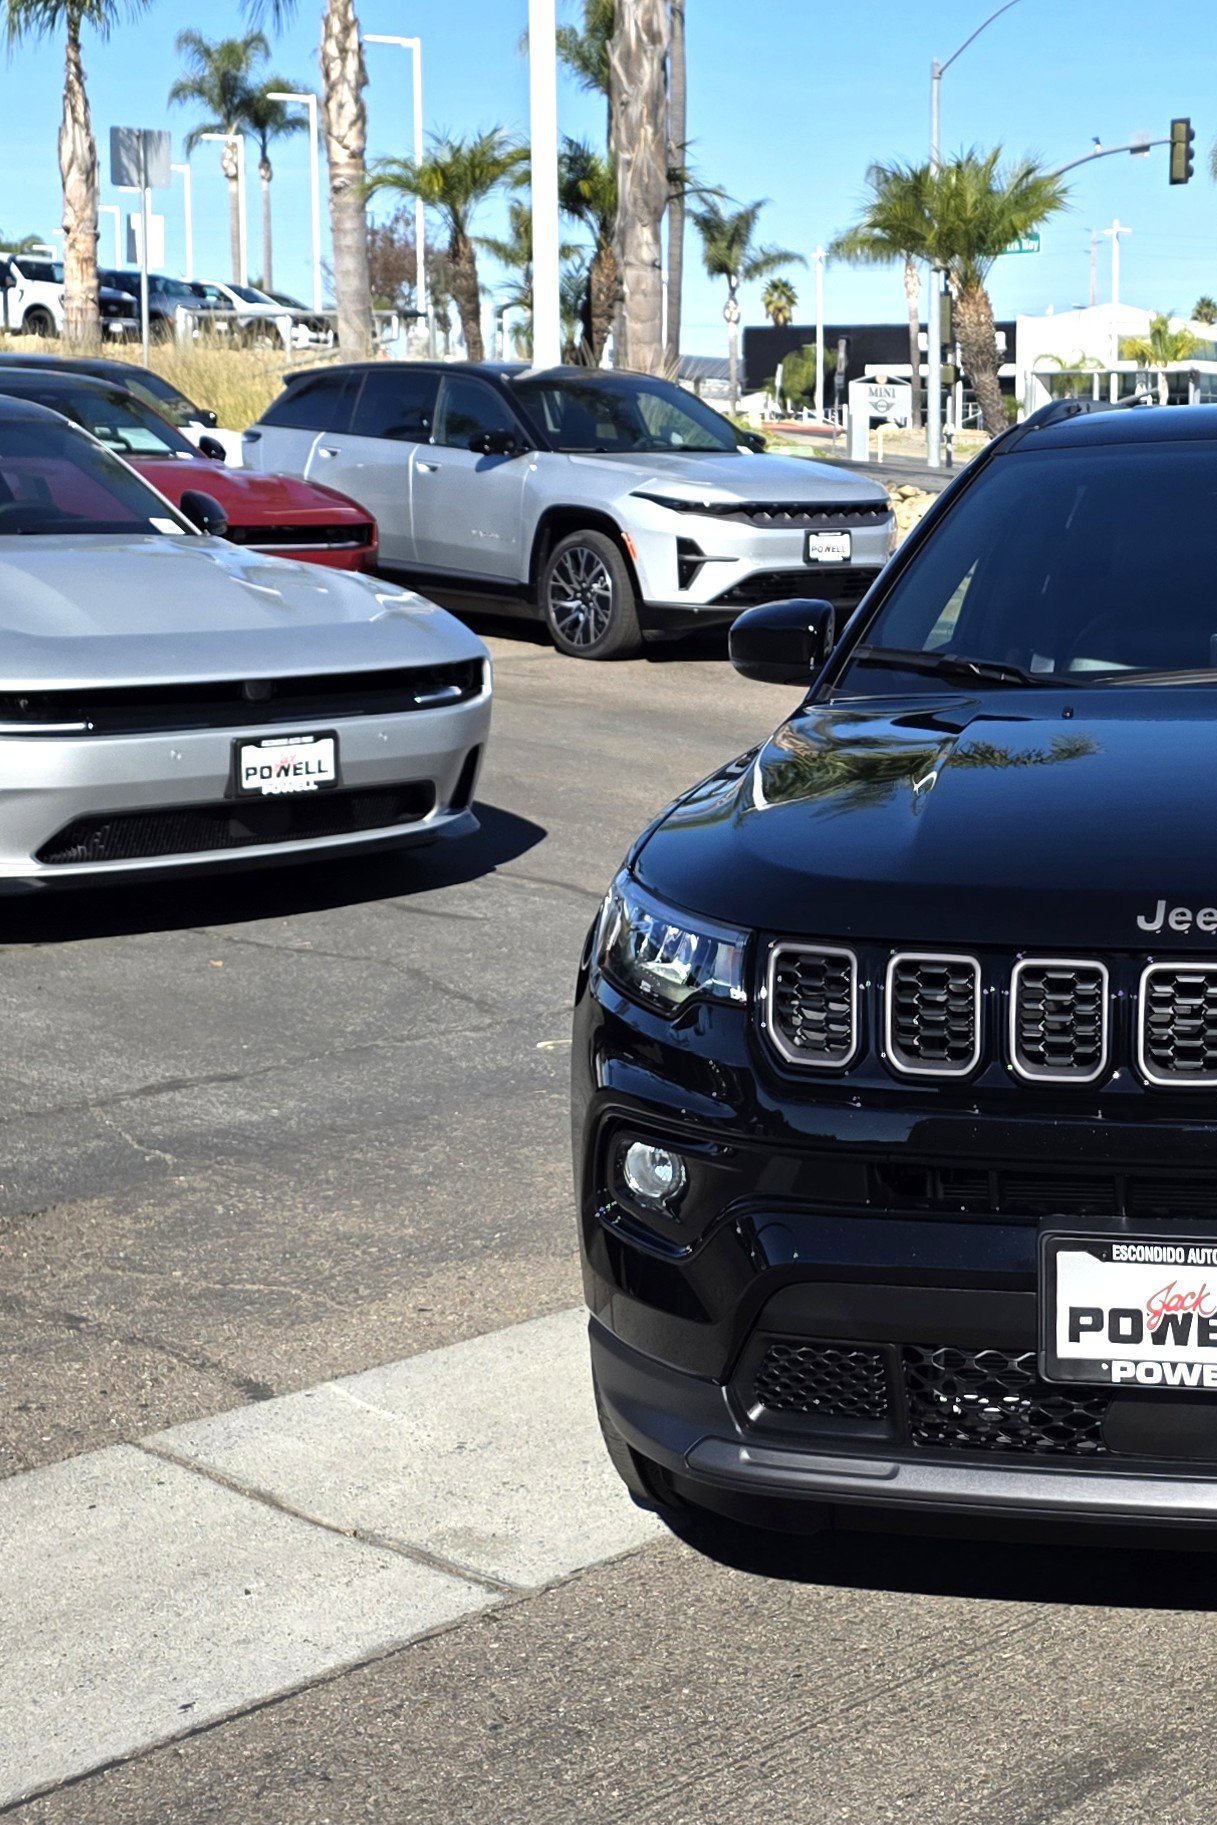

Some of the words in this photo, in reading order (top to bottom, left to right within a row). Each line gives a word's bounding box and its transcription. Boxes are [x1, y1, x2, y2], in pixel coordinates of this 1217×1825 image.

[868, 386, 896, 399] MINI
[811, 545, 847, 553] POWELL
[245, 760, 328, 781] POWELL
[1112, 1244, 1185, 1264] ESCONDIDO
[1146, 1280, 1217, 1331] Jack
